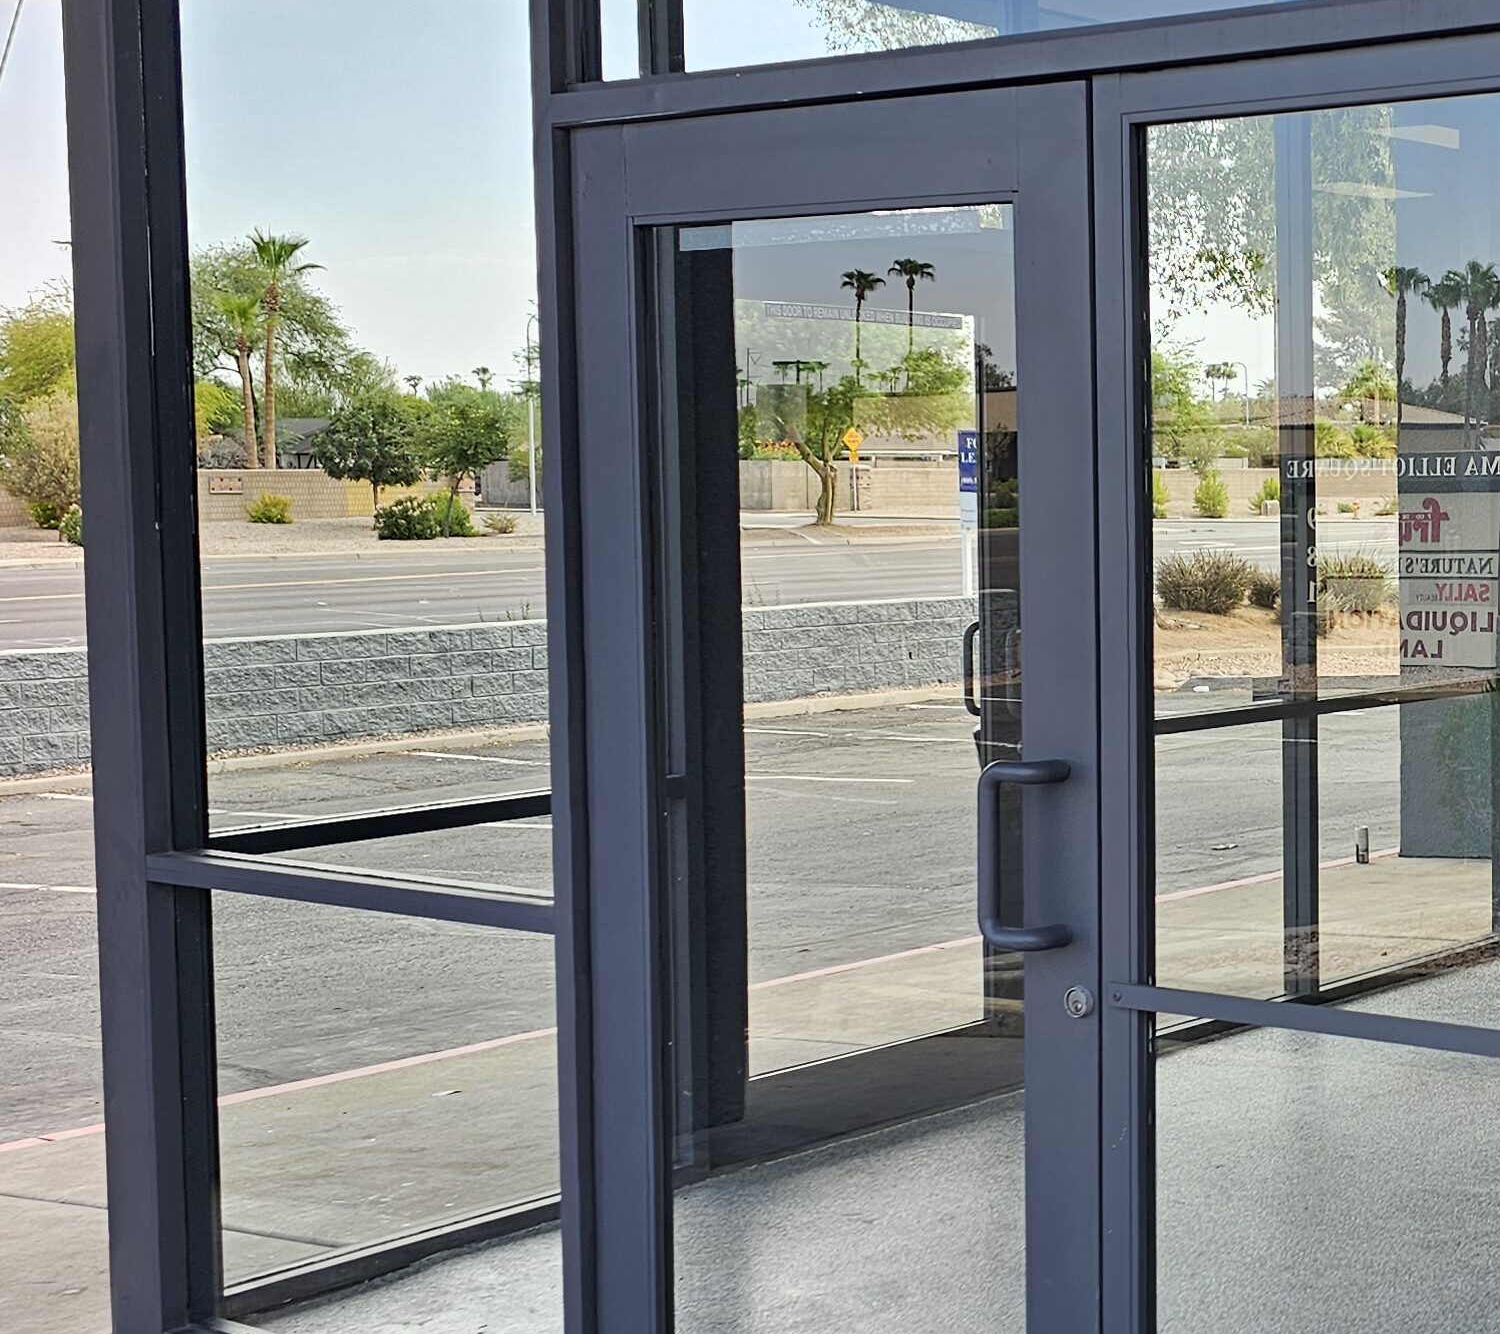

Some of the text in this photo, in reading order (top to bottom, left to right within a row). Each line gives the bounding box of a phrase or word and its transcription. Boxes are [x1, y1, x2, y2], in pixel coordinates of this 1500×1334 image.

[767, 304, 782, 316] THIS
[783, 305, 802, 317] DOOR
[803, 306, 813, 317] TO
[840, 308, 875, 321] UNLOKED
